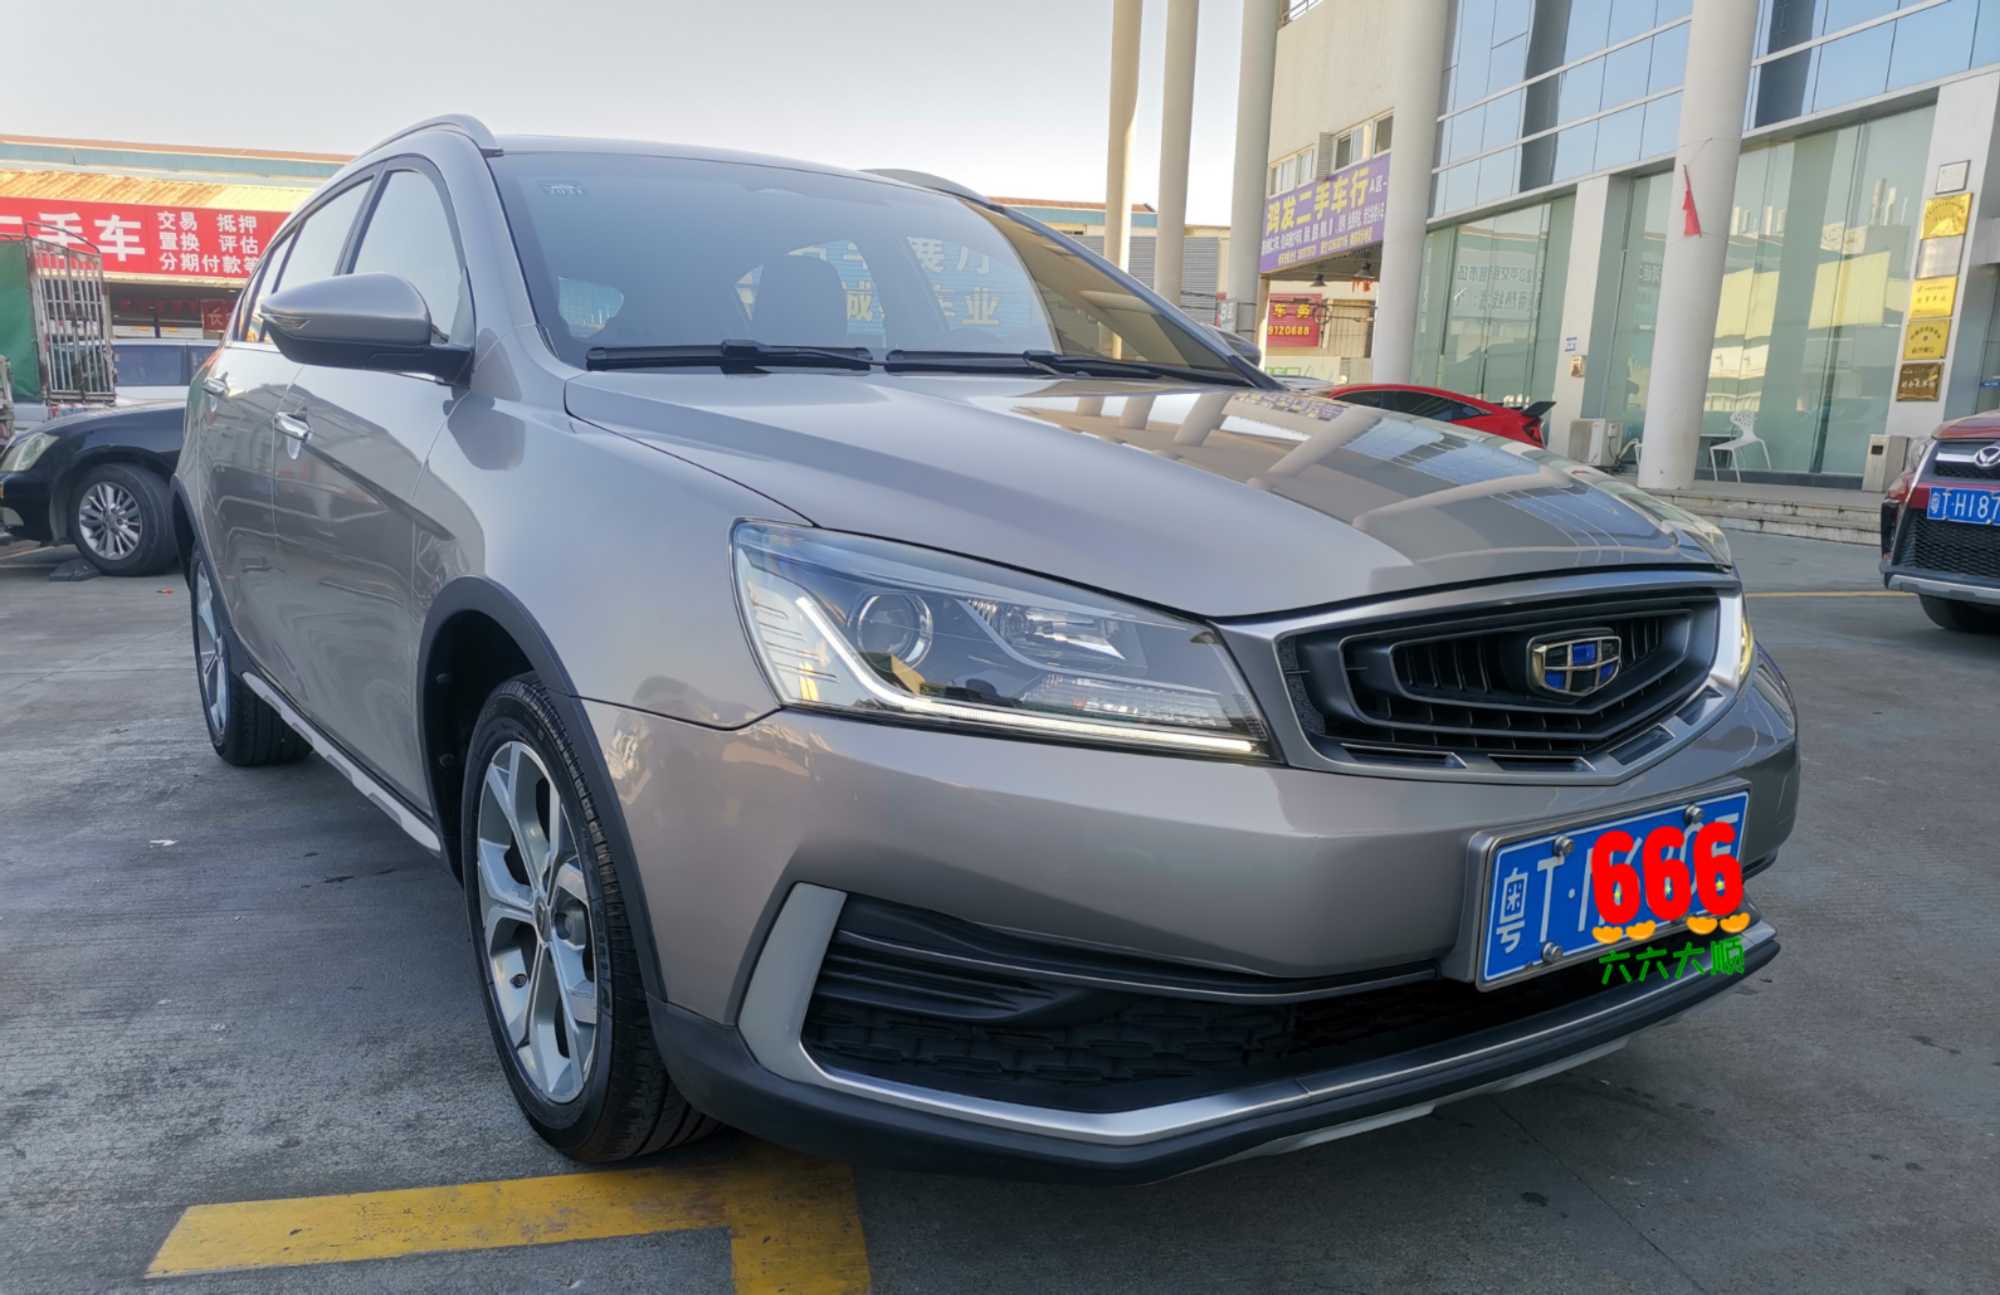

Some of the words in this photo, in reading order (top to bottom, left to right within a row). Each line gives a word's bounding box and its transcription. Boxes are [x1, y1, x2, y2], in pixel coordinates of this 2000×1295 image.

[157, 211, 198, 231] 交易
[217, 214, 257, 234] 抵押
[159, 231, 200, 252] 置换
[219, 234, 259, 255] 评估
